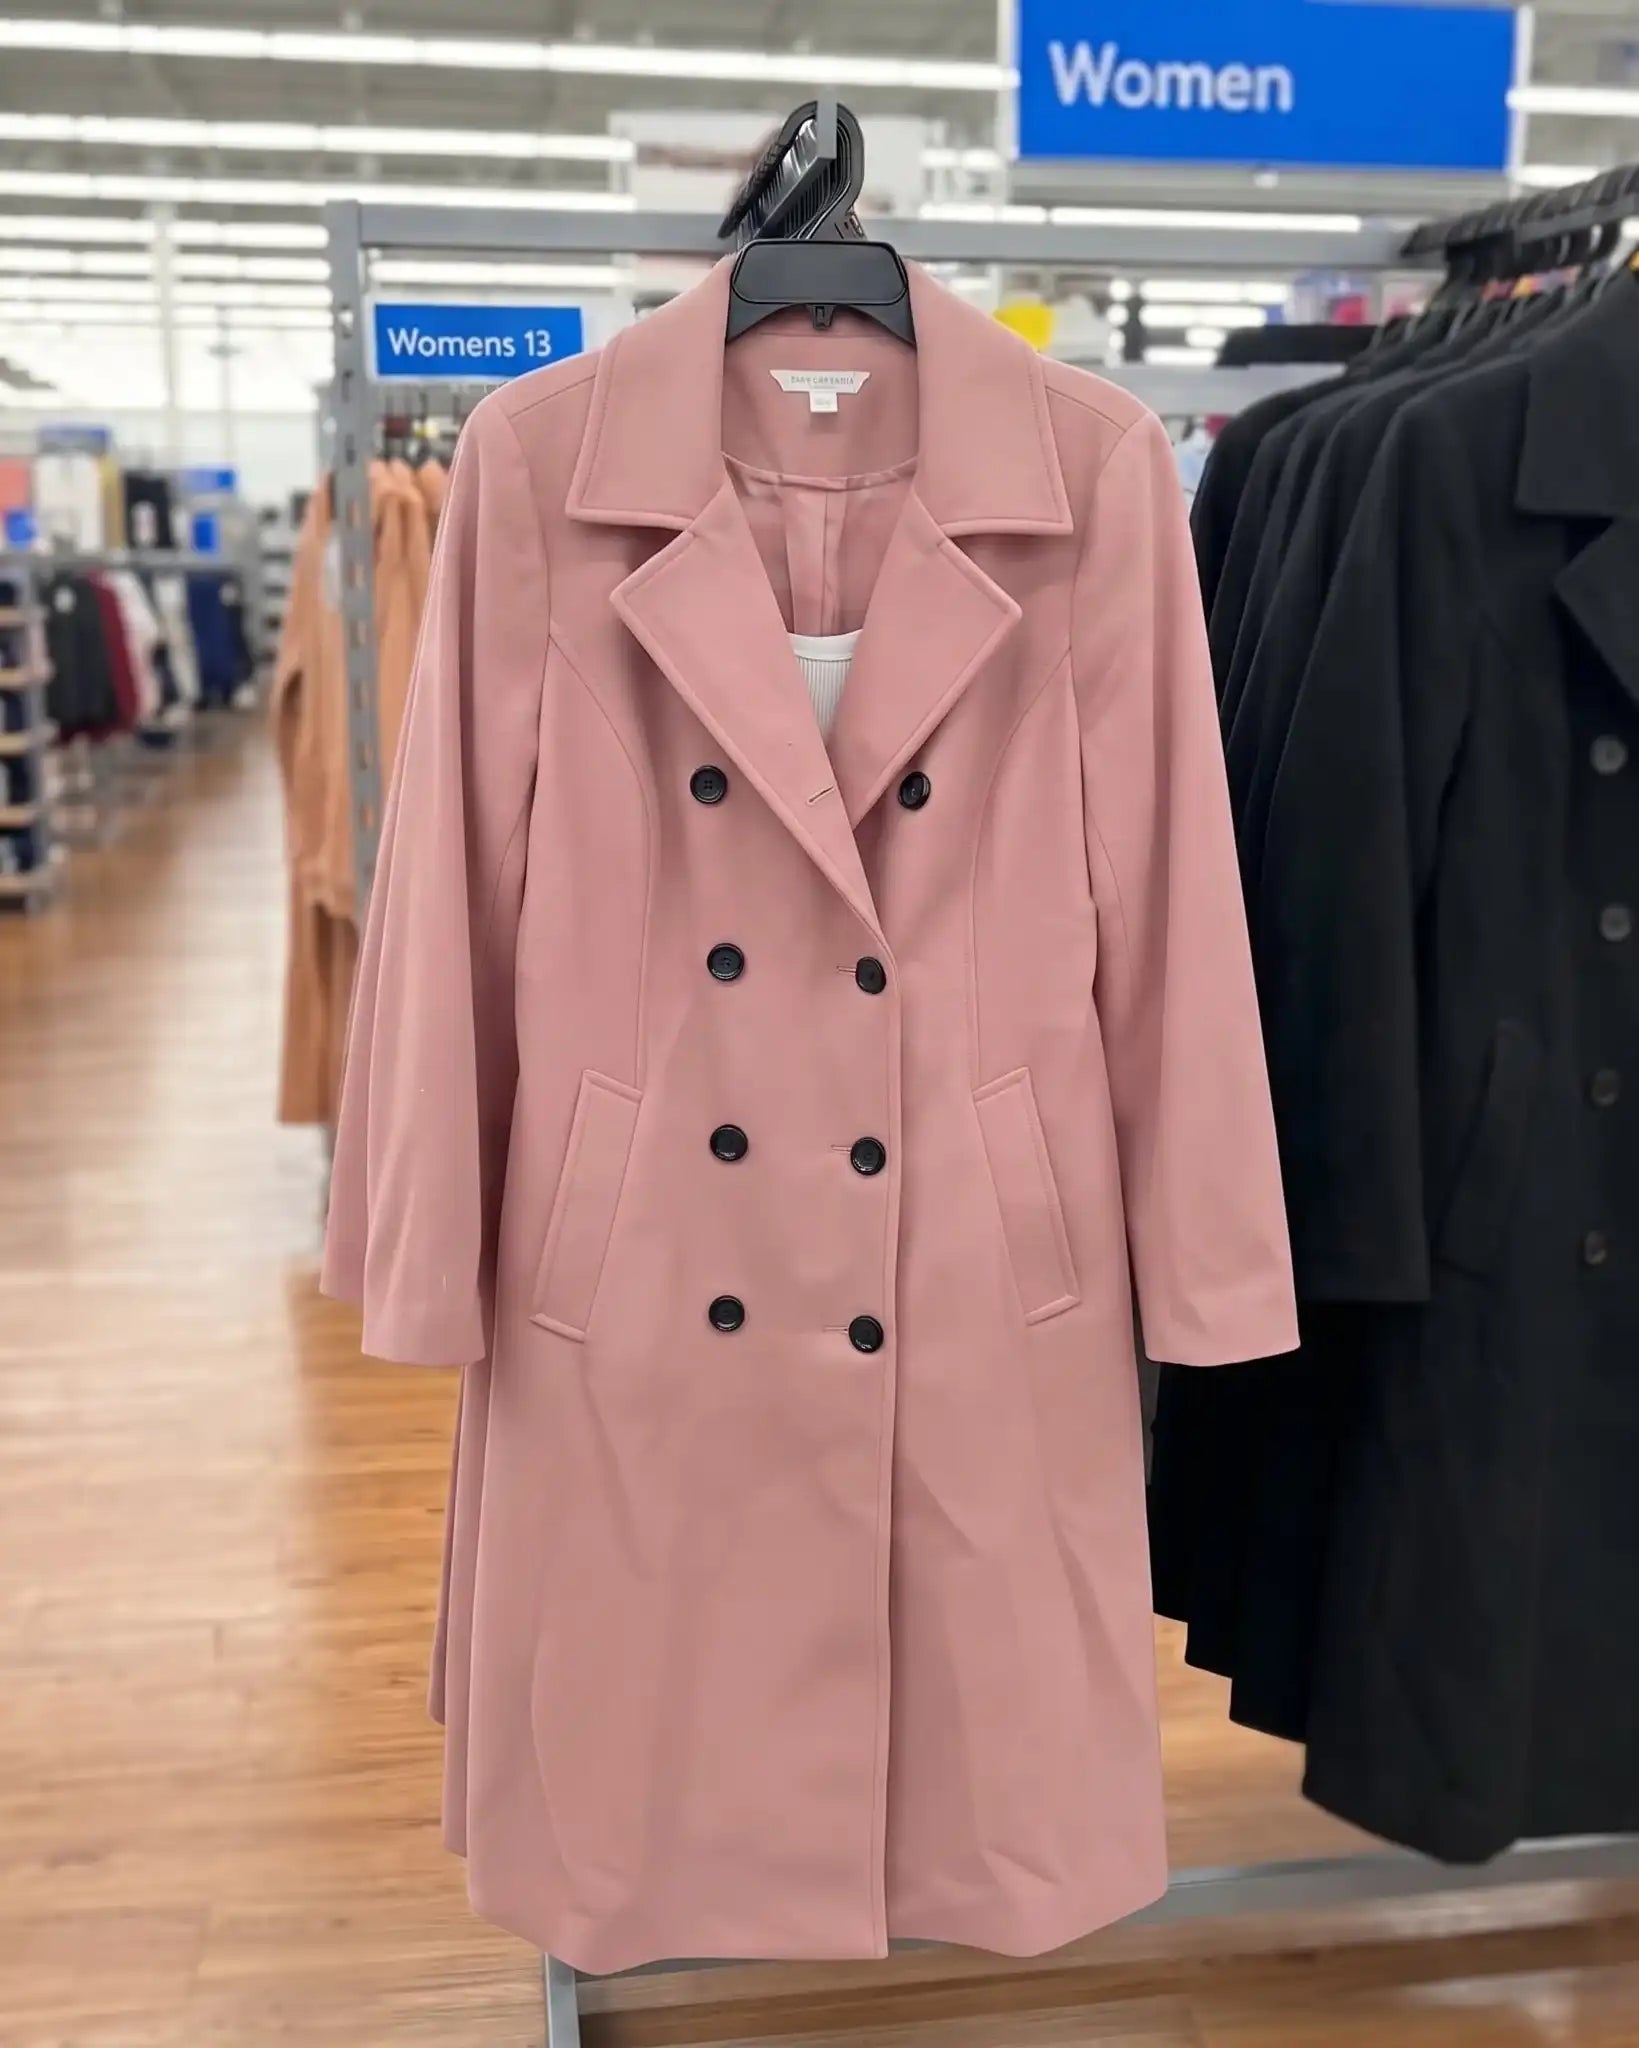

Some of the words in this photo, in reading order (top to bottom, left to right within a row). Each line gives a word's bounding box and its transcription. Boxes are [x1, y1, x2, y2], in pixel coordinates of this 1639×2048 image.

[1048, 40, 1294, 112] Women
[387, 327, 515, 358] Womens
[524, 330, 552, 358] 13
